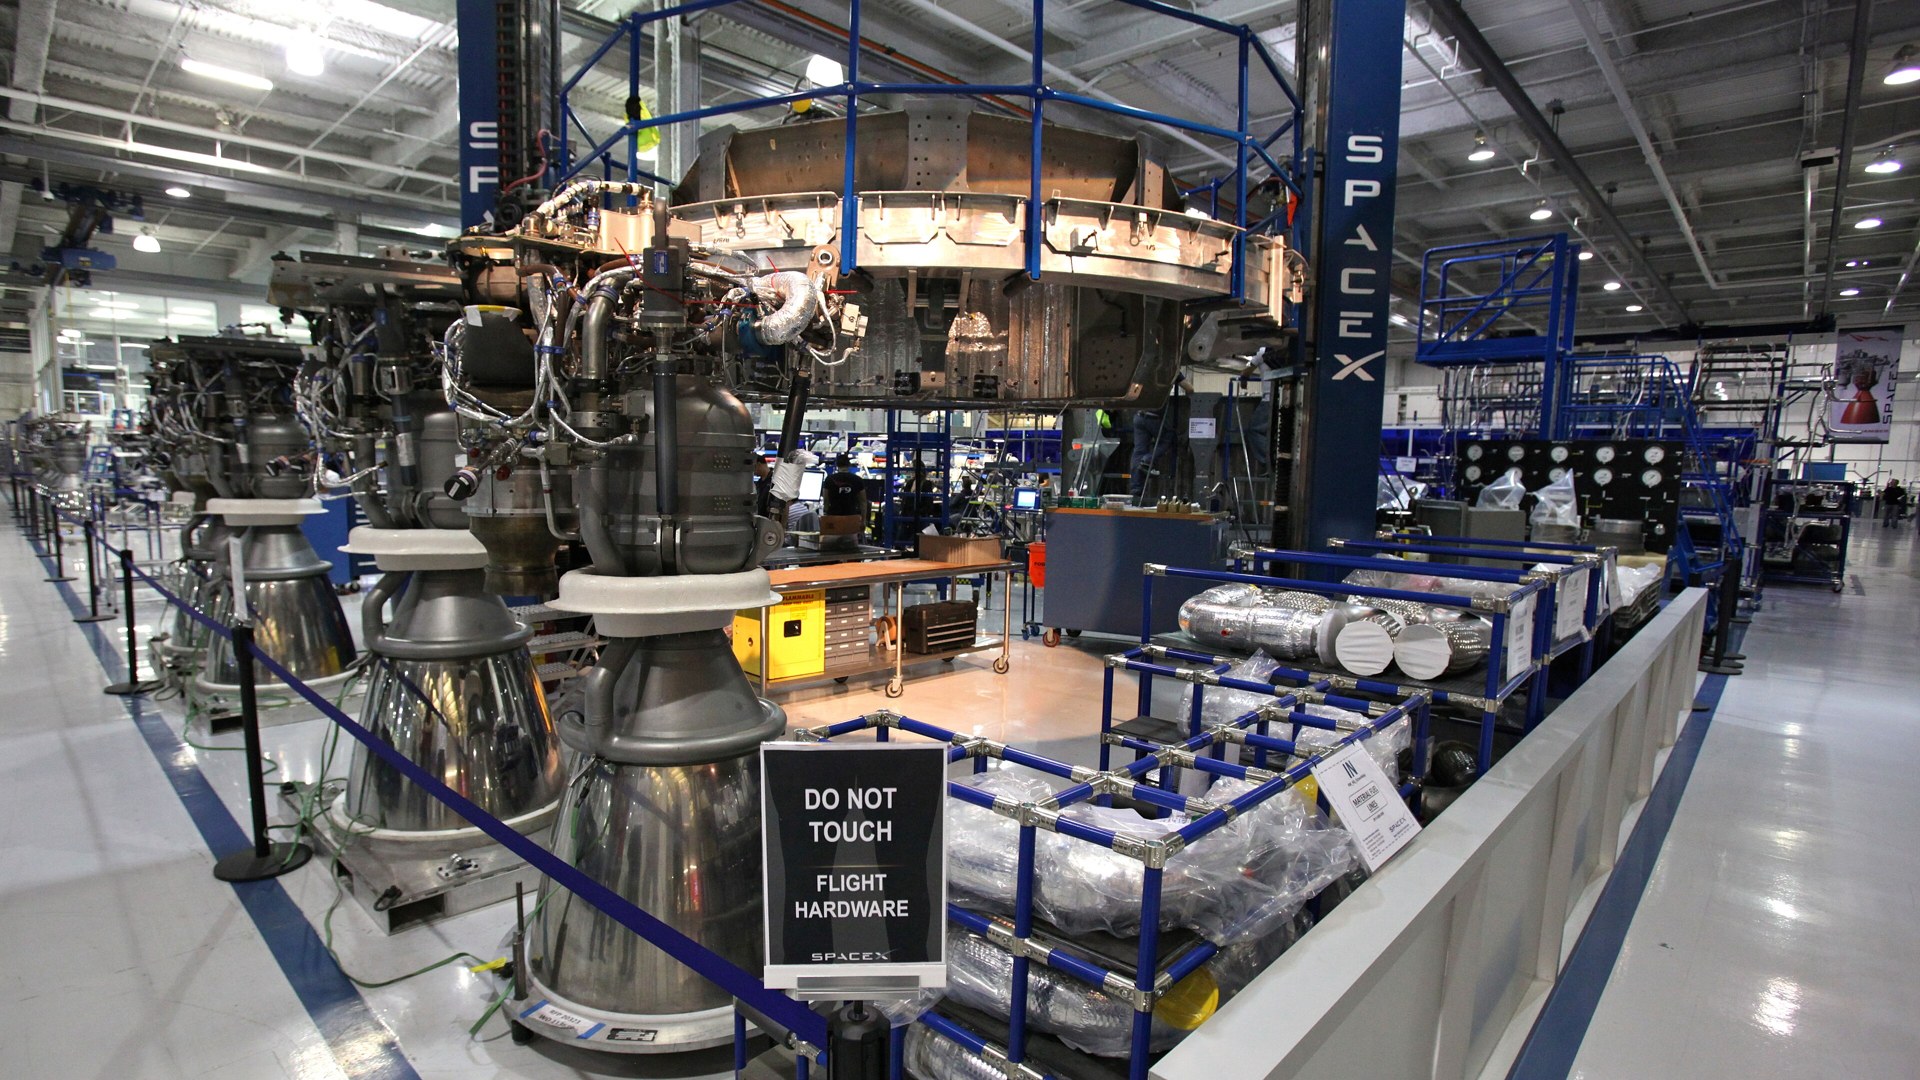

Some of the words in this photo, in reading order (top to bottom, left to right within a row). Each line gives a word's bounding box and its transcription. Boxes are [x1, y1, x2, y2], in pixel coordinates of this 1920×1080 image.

[1331, 135, 1385, 382] SPACEX
[1882, 358, 1900, 425] SPACEX
[838, 486, 852, 494] F9
[1342, 760, 1358, 779] IN
[804, 788, 840, 810] DO
[847, 787, 898, 810] NOT
[1352, 790, 1372, 806] MATERIAL
[1366, 800, 1378, 812] LINES
[808, 821, 893, 842] TOUCH
[816, 874, 887, 892] FLIGHT
[795, 900, 909, 918] HARDWARE
[811, 951, 893, 961] SPACEX
